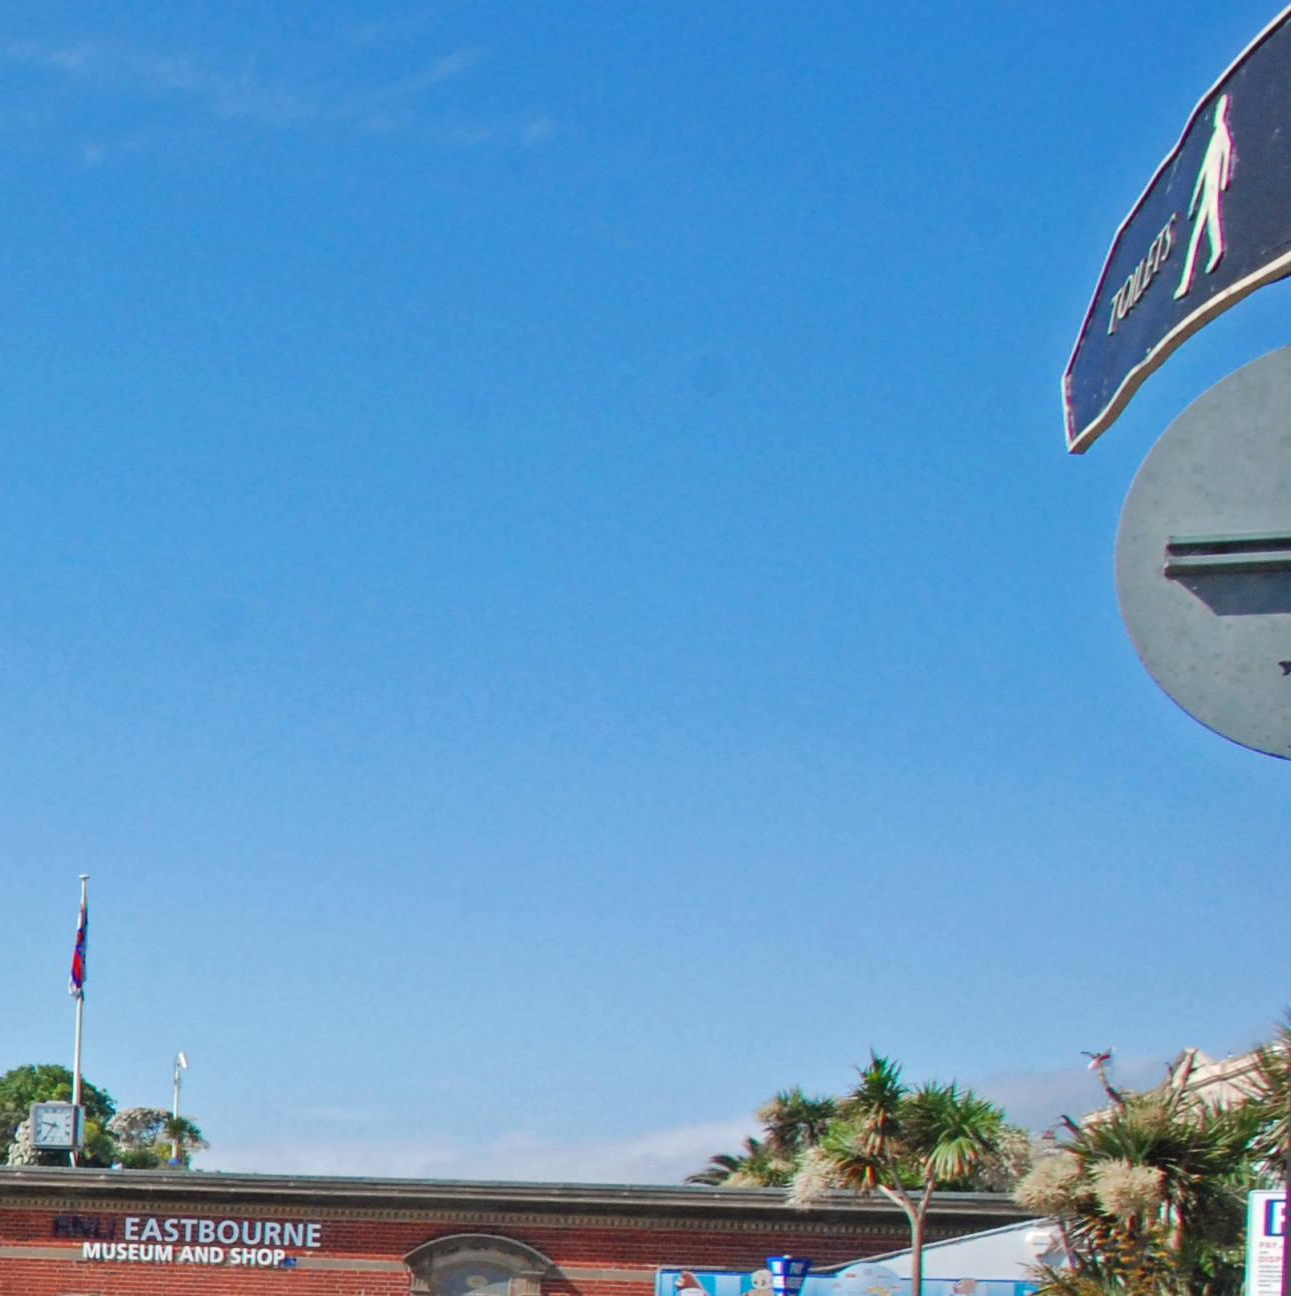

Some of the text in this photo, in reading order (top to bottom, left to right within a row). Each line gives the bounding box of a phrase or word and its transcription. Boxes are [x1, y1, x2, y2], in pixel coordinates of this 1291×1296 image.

[1107, 211, 1180, 336] TOILETS
[54, 1215, 322, 1248] RNLI EASTBOURNE
[1259, 1241, 1278, 1249] PAY
[82, 1241, 286, 1266] MUSEUM AND SHOP
